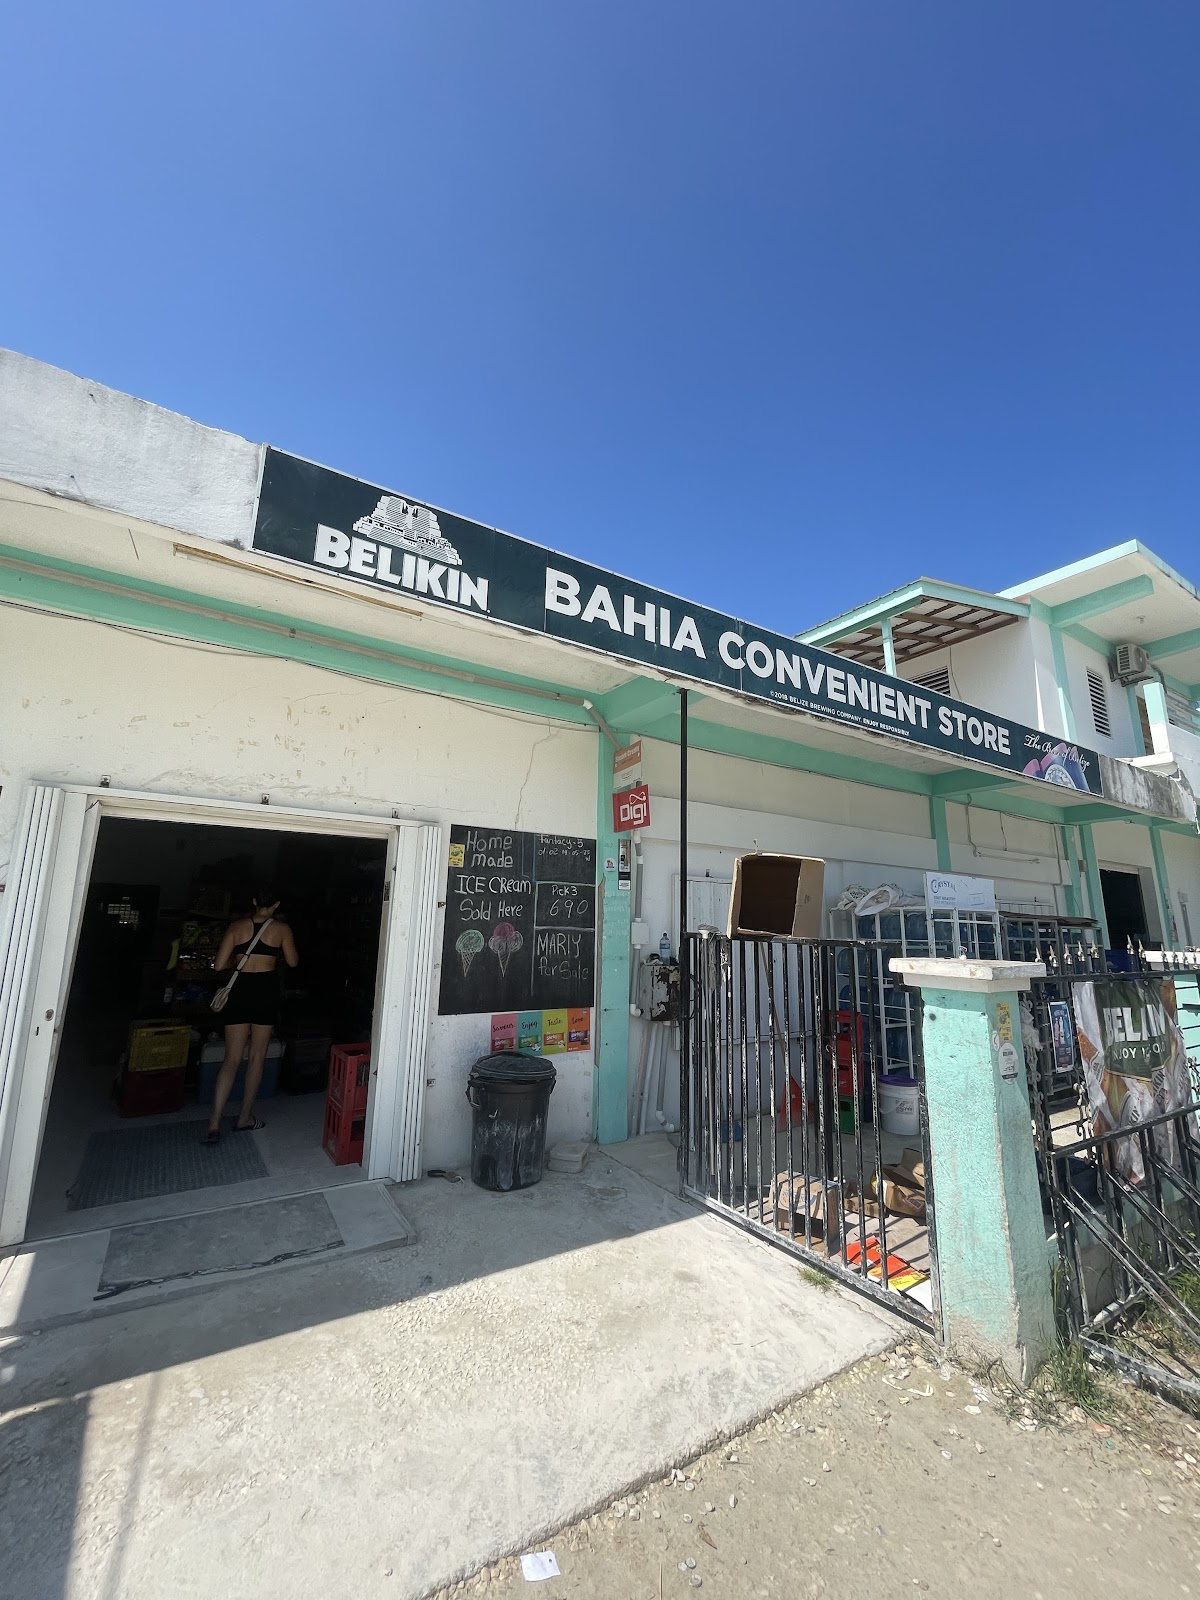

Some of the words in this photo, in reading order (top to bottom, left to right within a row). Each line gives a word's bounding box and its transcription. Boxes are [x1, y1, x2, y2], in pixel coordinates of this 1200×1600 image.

[313, 523, 489, 612] BELIKIN
[545, 567, 706, 660] BAHIA
[718, 631, 931, 729] CONVENIENT
[938, 707, 1011, 756] STORE
[790, 696, 809, 707] BELIZE
[810, 702, 835, 715] BREWING
[863, 718, 879, 728] ENJOY
[1023, 734, 1041, 751] The
[466, 830, 513, 852] Home
[471, 851, 514, 868] made
[454, 874, 487, 895] ICE
[459, 898, 492, 921] Sold
[498, 899, 524, 918] Here
